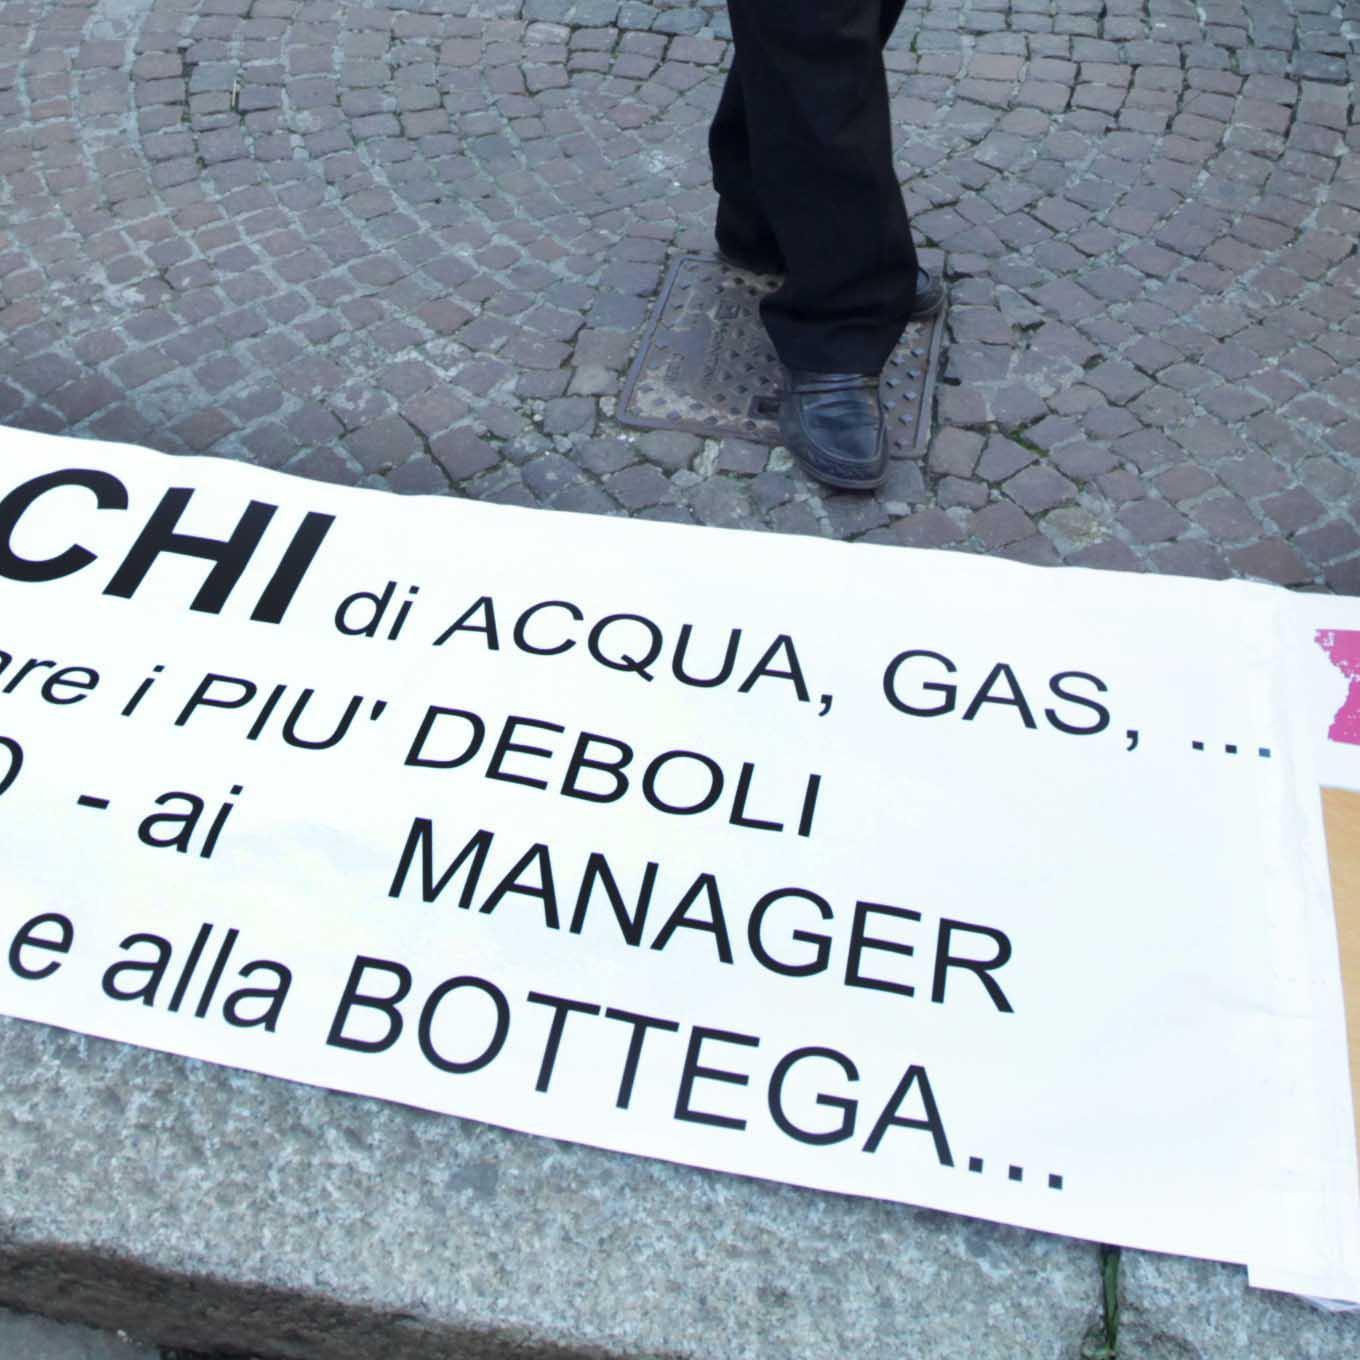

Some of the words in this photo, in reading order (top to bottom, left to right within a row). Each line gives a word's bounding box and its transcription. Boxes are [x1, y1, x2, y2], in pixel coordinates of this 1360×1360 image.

[121, 665, 165, 717] i
[174, 672, 389, 751] PIU'
[403, 704, 822, 838] DEBOLI
[335, 578, 419, 641] di
[433, 596, 833, 718] ACQUA,
[882, 649, 1139, 752] GAS,
[8, 912, 74, 980] e
[101, 922, 293, 1033] alla
[137, 784, 244, 860] ai
[388, 816, 1014, 1014] MANAGER
